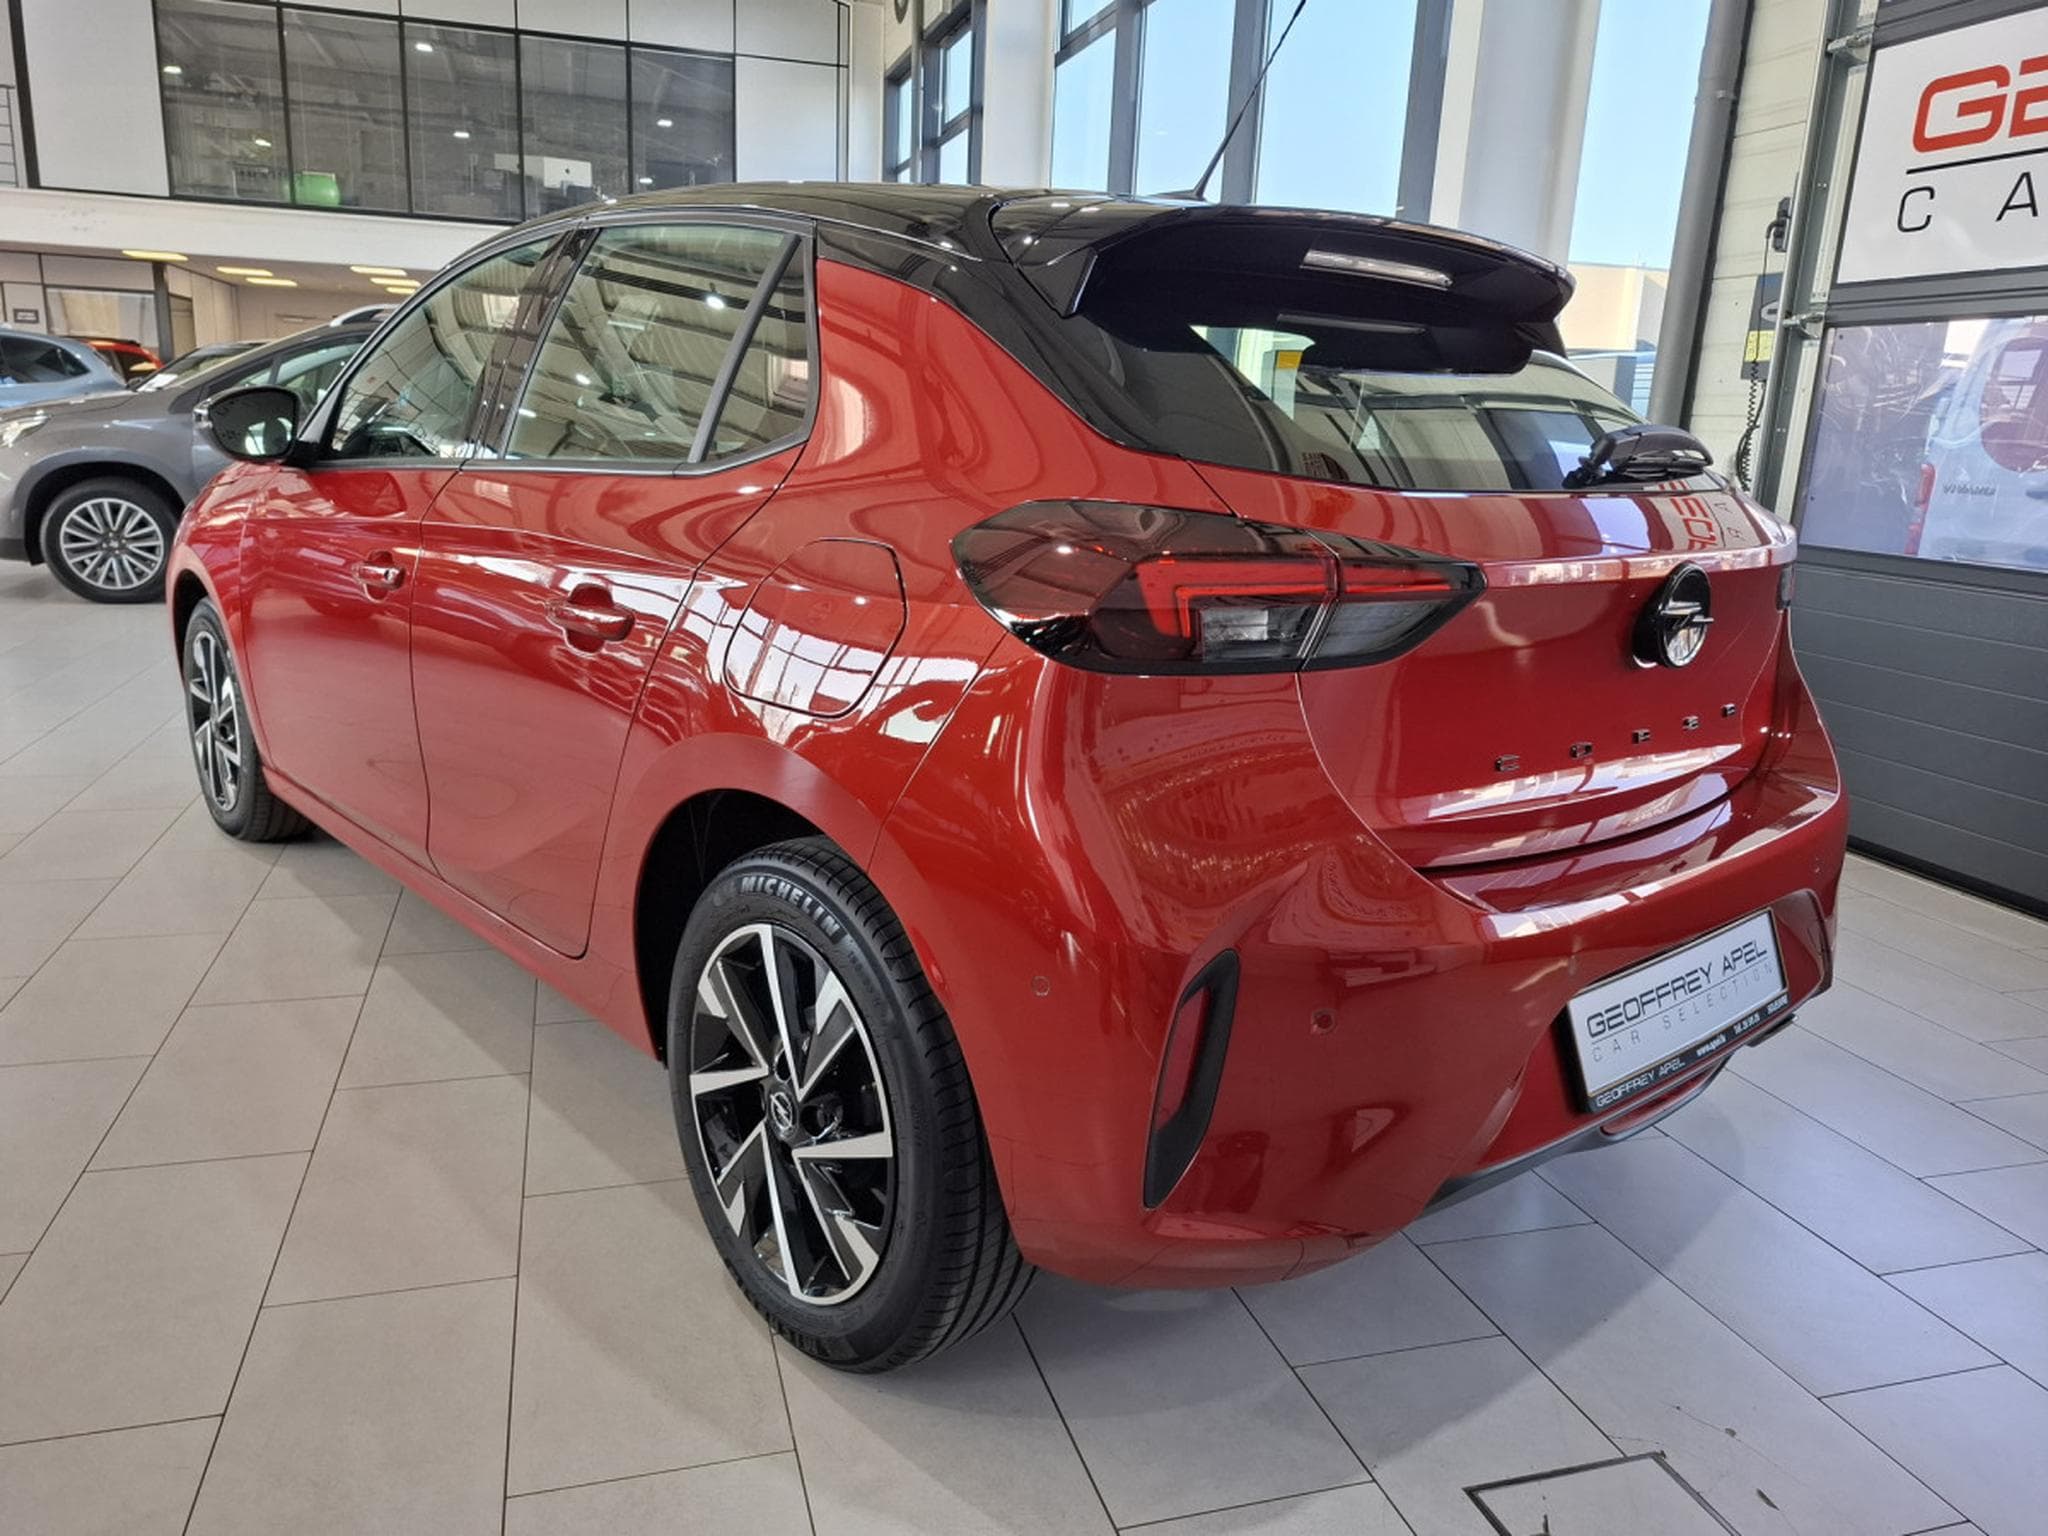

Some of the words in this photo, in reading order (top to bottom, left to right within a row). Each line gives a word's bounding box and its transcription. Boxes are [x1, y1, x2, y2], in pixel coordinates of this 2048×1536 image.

[740, 876, 841, 936] MICHELIN
[1585, 963, 1713, 1039] GEOFFREY
[1722, 940, 1768, 976] APEL
[1593, 1029, 1642, 1062] CAR
[1663, 962, 1774, 1030] SELECTION
[1596, 1069, 1655, 1107] GEOFFREY
